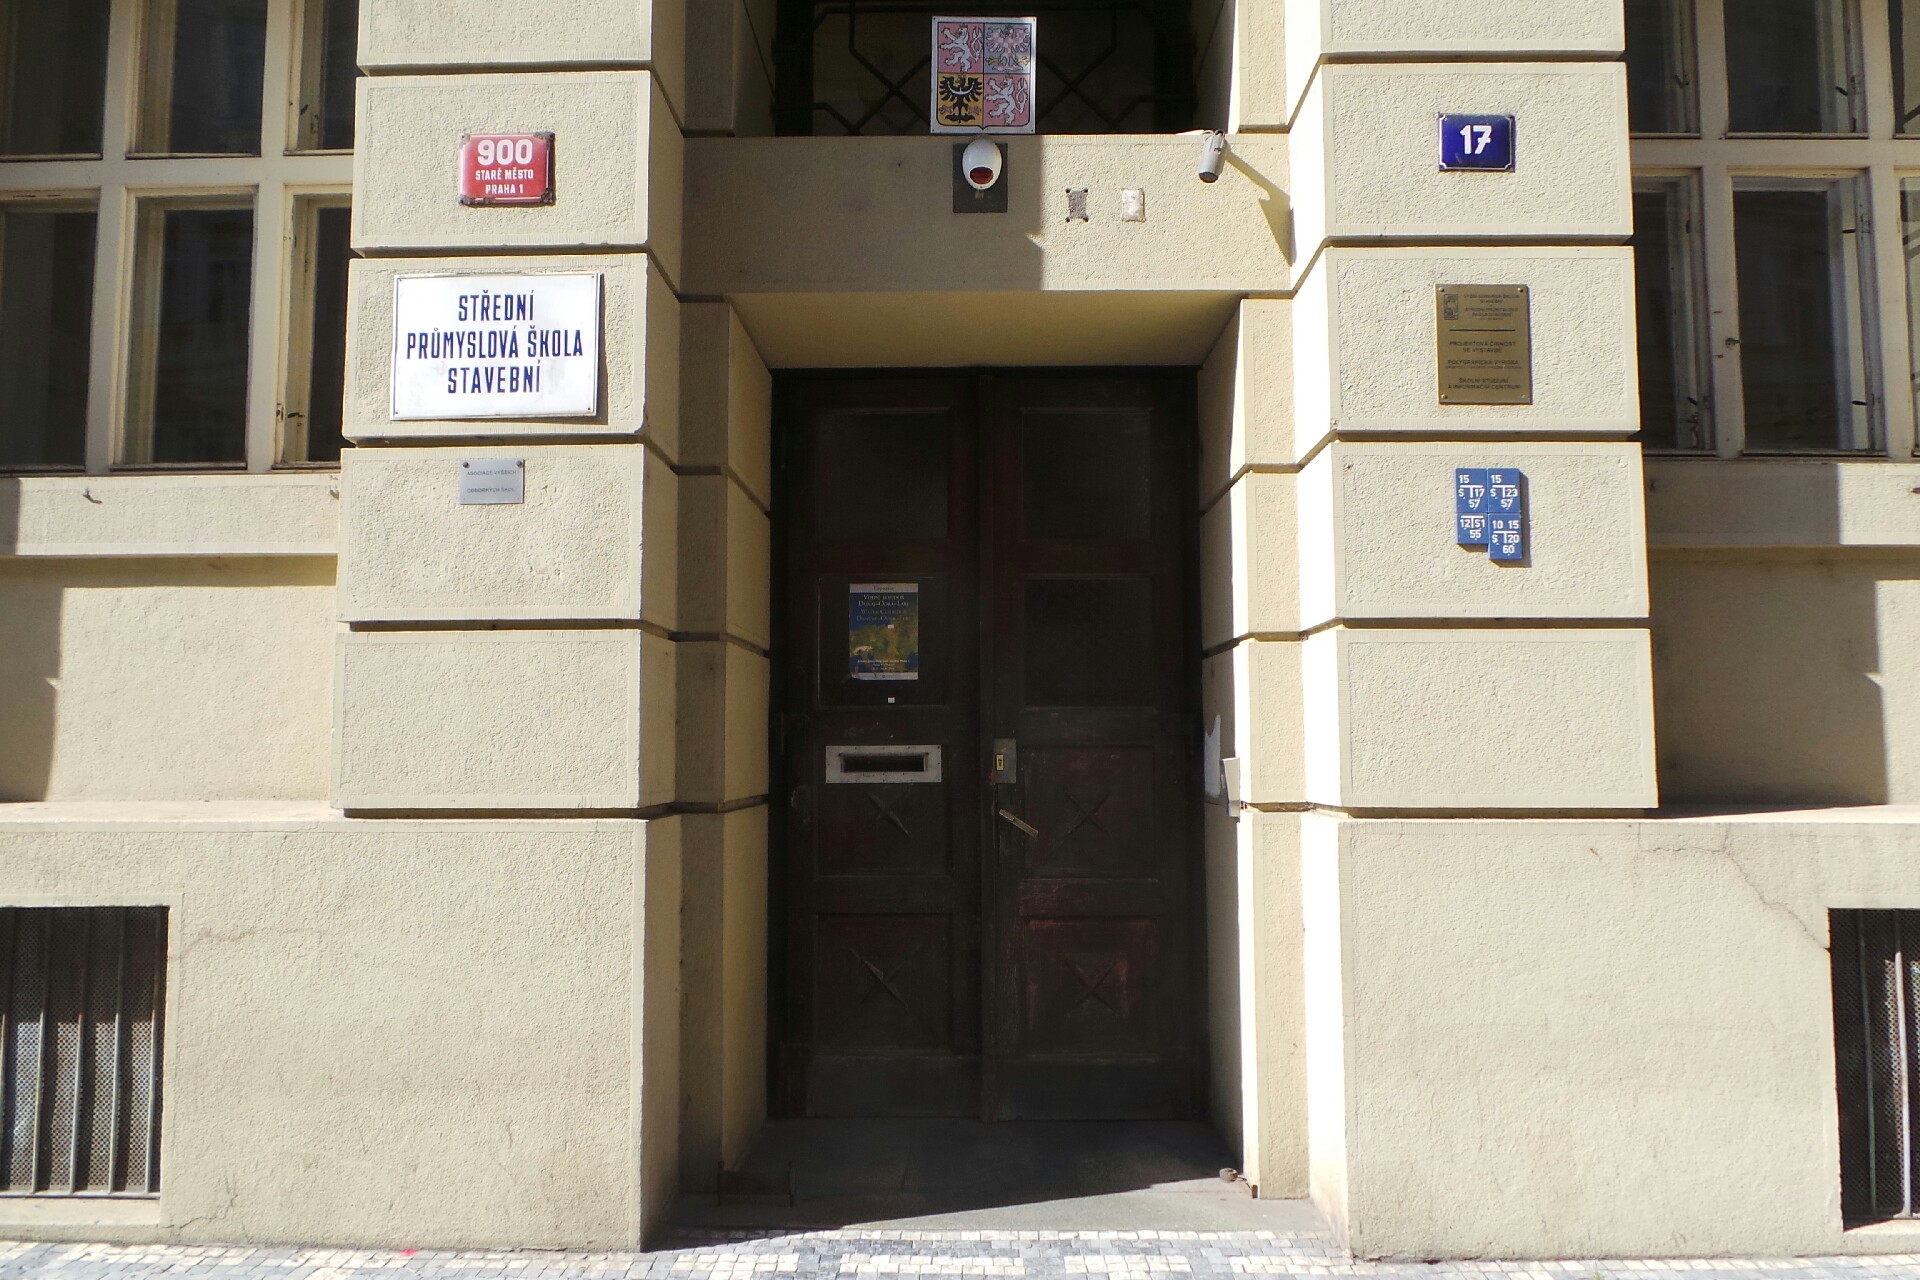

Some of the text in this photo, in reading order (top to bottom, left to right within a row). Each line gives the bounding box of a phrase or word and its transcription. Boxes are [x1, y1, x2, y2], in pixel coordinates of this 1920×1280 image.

[1460, 125, 1492, 154] 17
[477, 139, 533, 166] 900
[475, 167, 534, 180] STARÉ MĚSTO
[485, 184, 524, 194] PRAHA 1
[458, 289, 535, 322] STŘEDNÍ
[406, 324, 584, 359] PRŮMYSLOVÁ ŠKOLA
[447, 360, 541, 394] STAVEBNÍ
[1459, 475, 1470, 484] 15
[1491, 475, 1502, 484] 15
[1506, 488, 1518, 498] 23
[1492, 520, 1519, 529] 10 15
[1508, 534, 1520, 543] 20
[1503, 545, 1515, 554] 60
